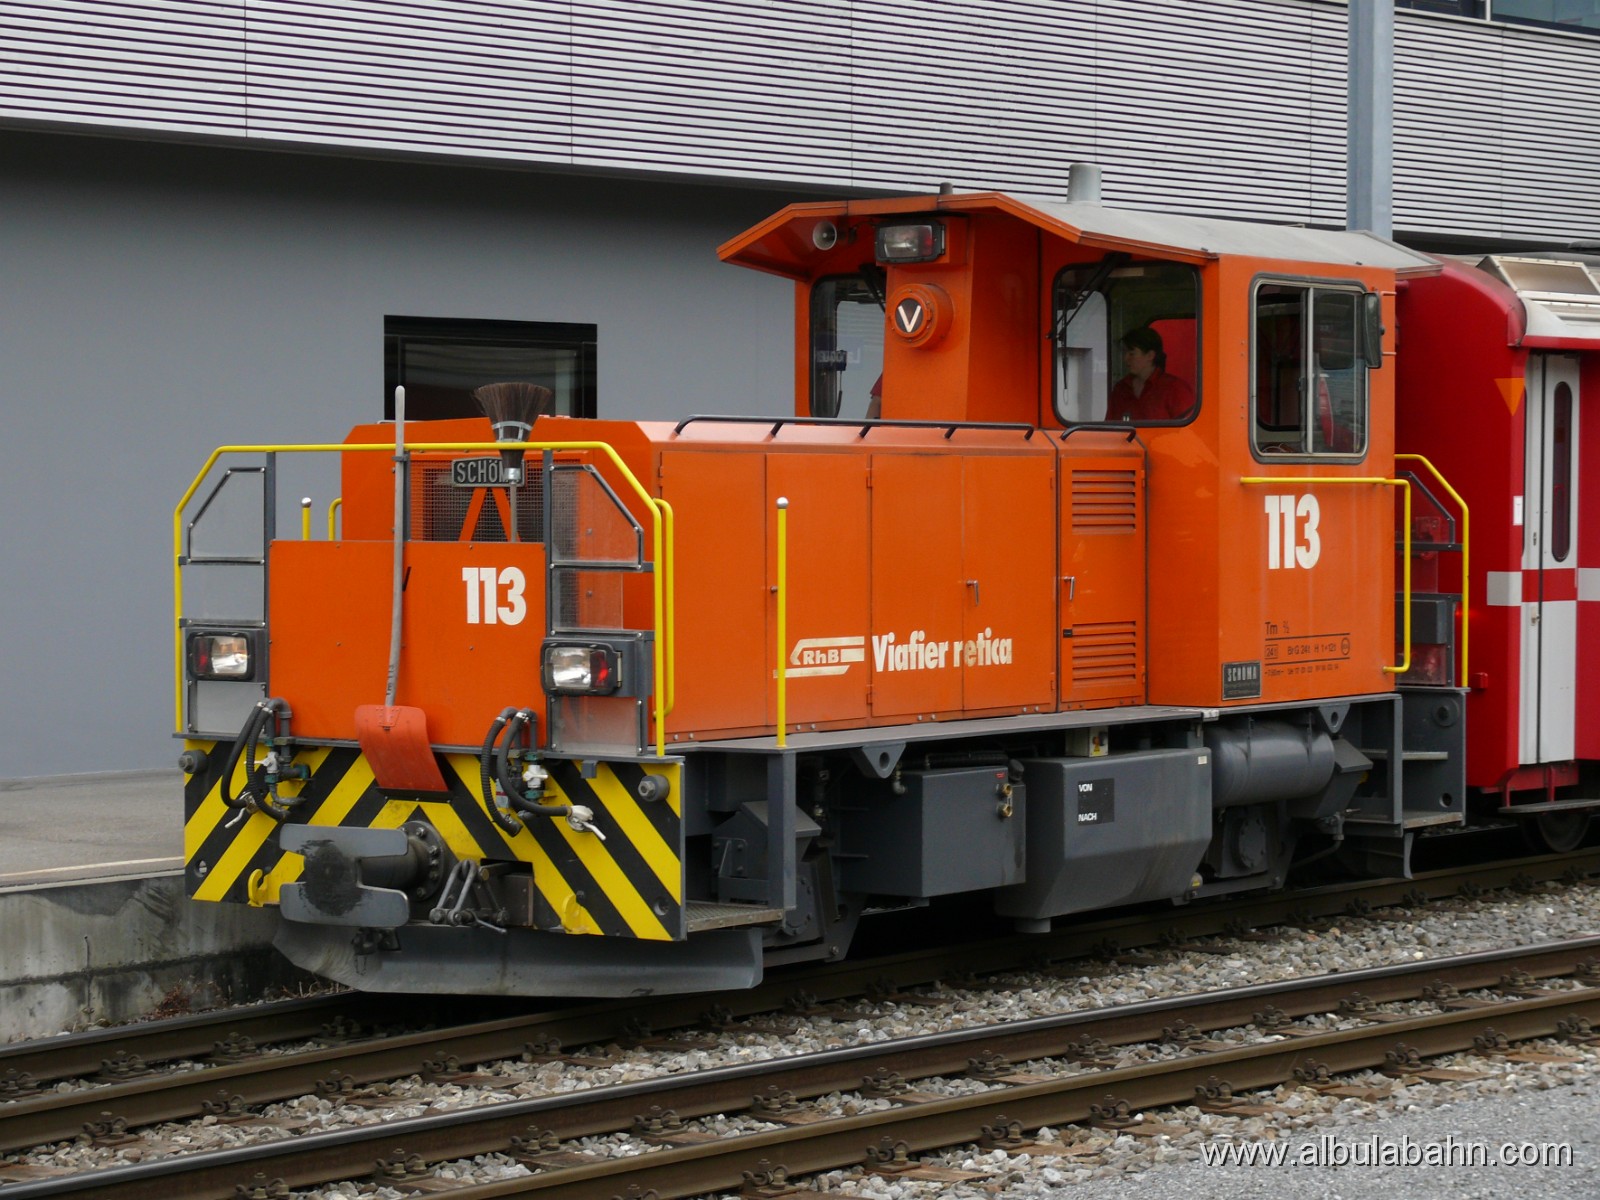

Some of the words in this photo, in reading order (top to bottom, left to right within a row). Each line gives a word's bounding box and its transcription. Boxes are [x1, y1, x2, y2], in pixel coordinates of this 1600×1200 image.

[897, 304, 922, 333] V
[456, 460, 519, 483] SCHÖM
[1264, 493, 1321, 570] 113
[462, 566, 527, 625] 113
[1264, 621, 1278, 635] Tm
[803, 649, 840, 665] RhB
[872, 630, 949, 673] Viafier
[953, 626, 1013, 668] retica
[1078, 783, 1093, 793] VON
[1078, 812, 1098, 822] NACH
